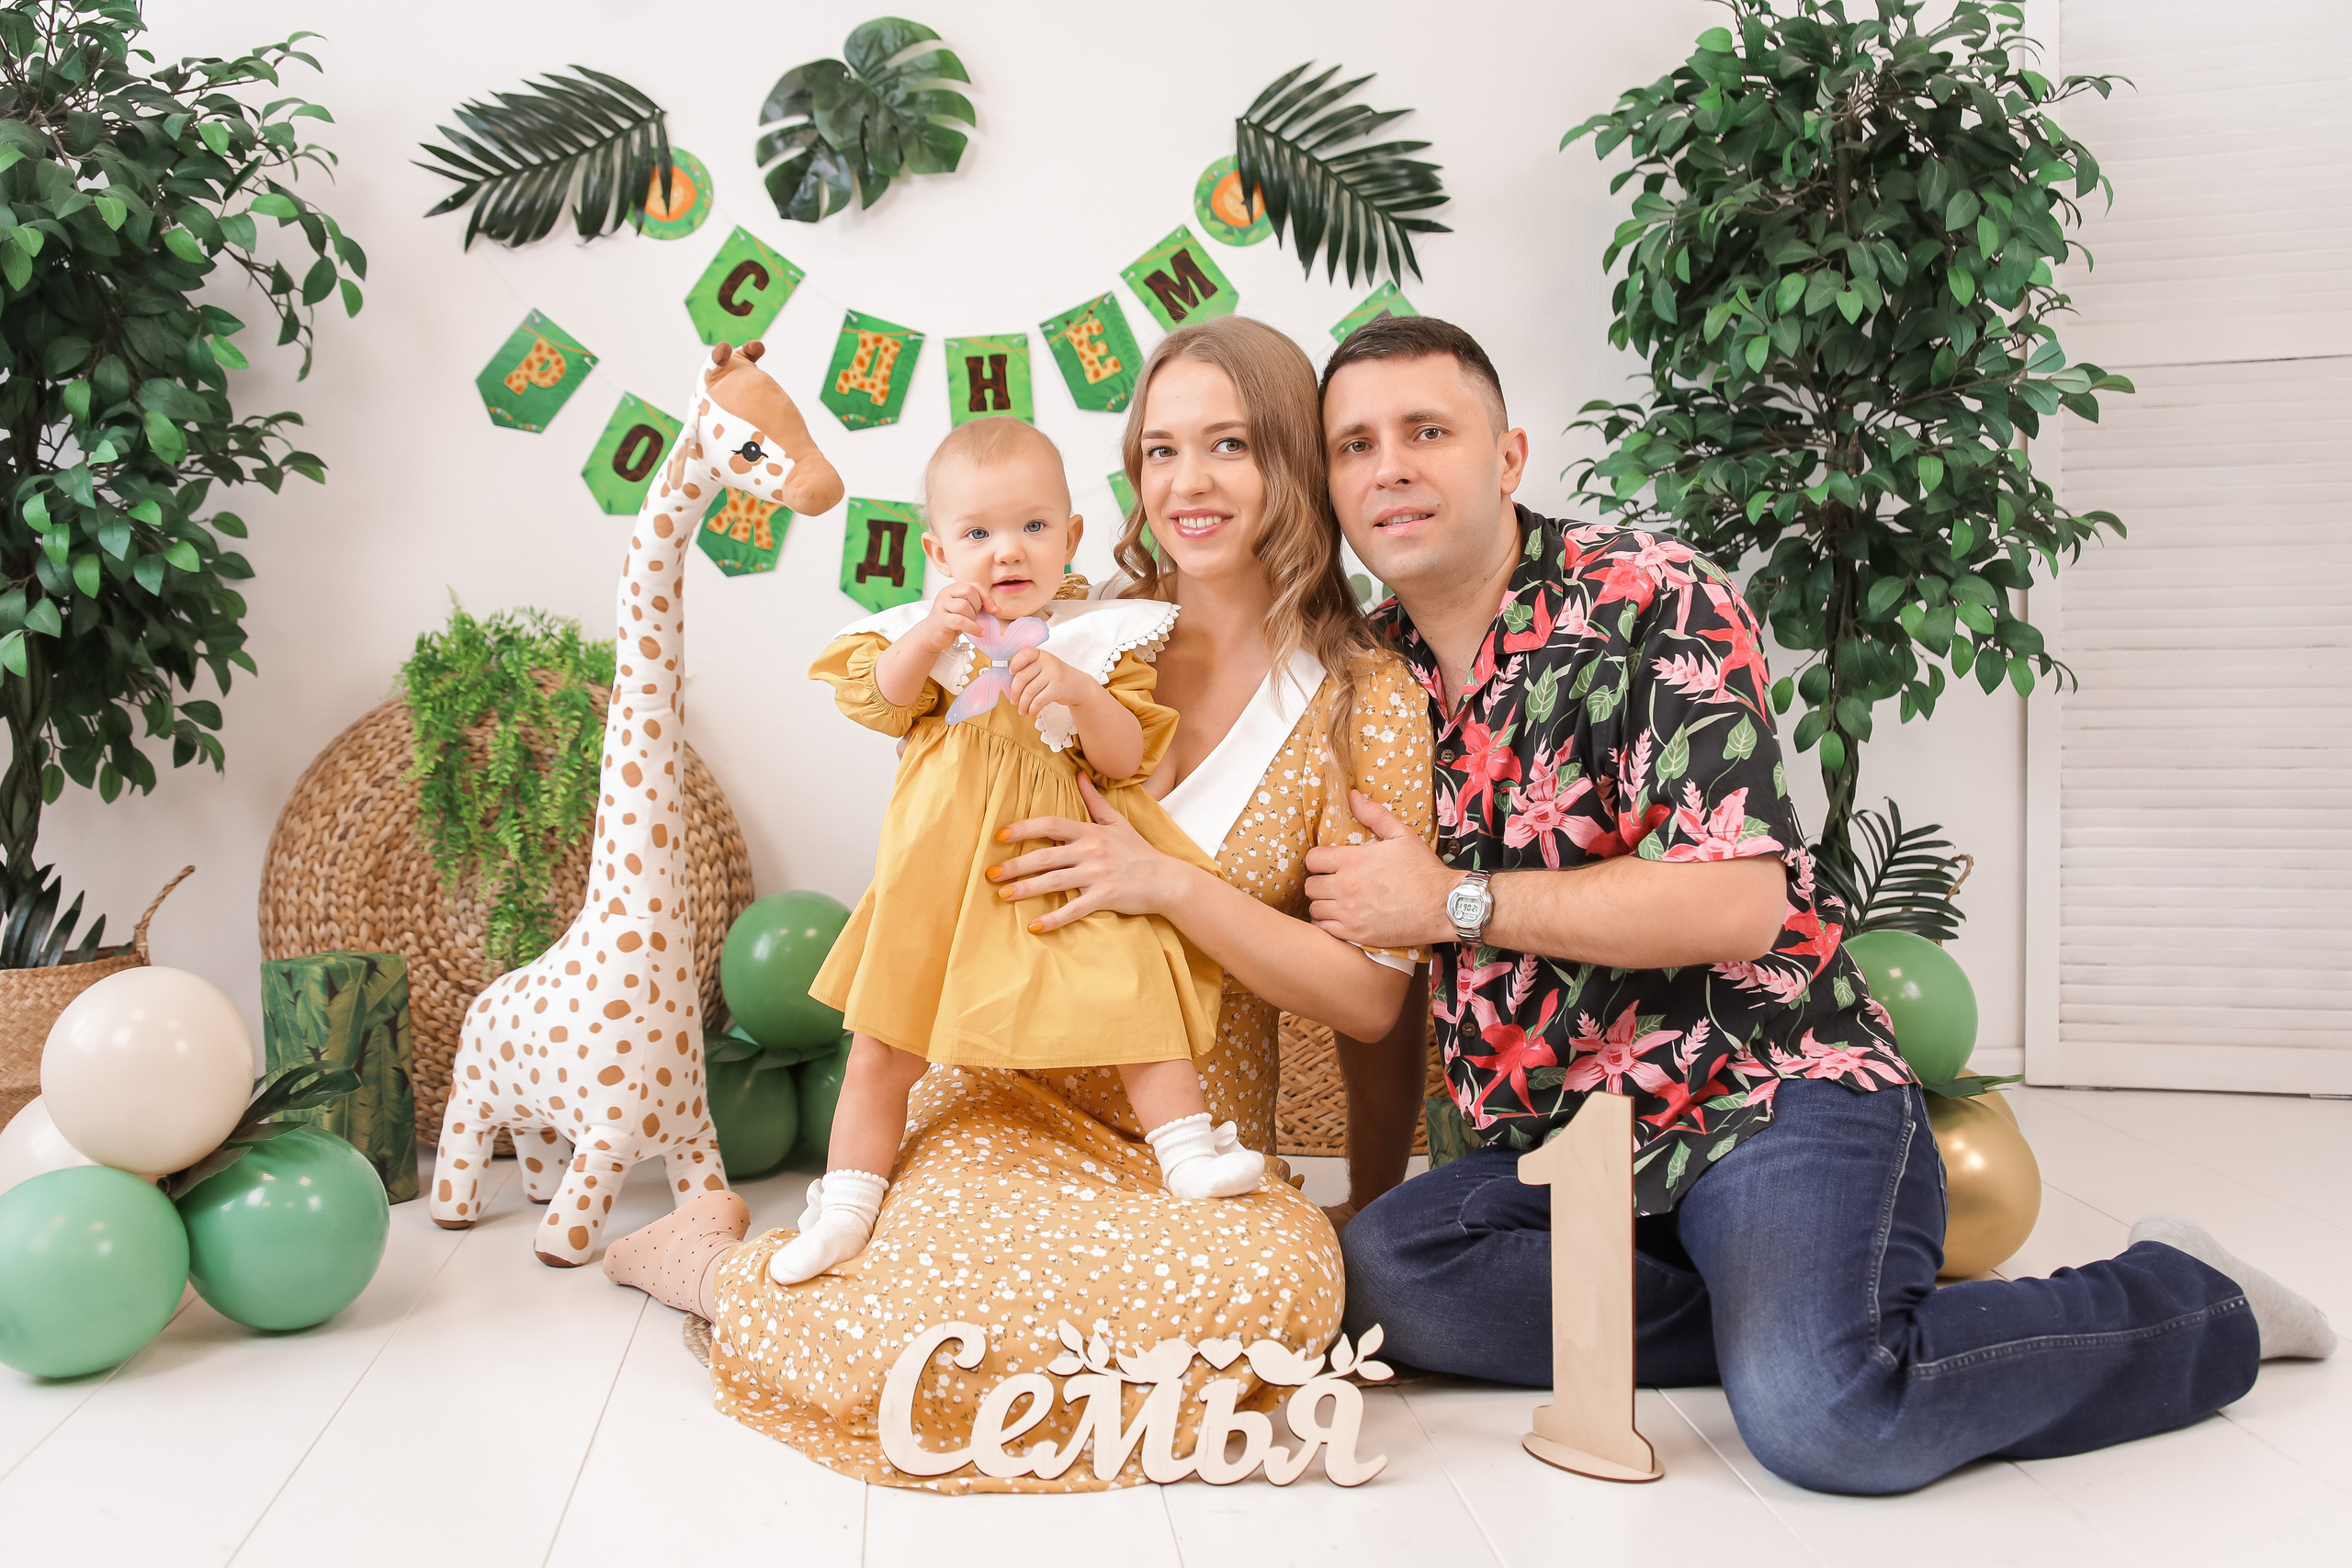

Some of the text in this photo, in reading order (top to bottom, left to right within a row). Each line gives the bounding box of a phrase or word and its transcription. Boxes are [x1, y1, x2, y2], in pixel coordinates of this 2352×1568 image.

[718, 247, 1220, 413] С ДНЕМ
[1517, 1090, 1665, 1483] 1
[877, 1320, 1389, 1488] Семья
